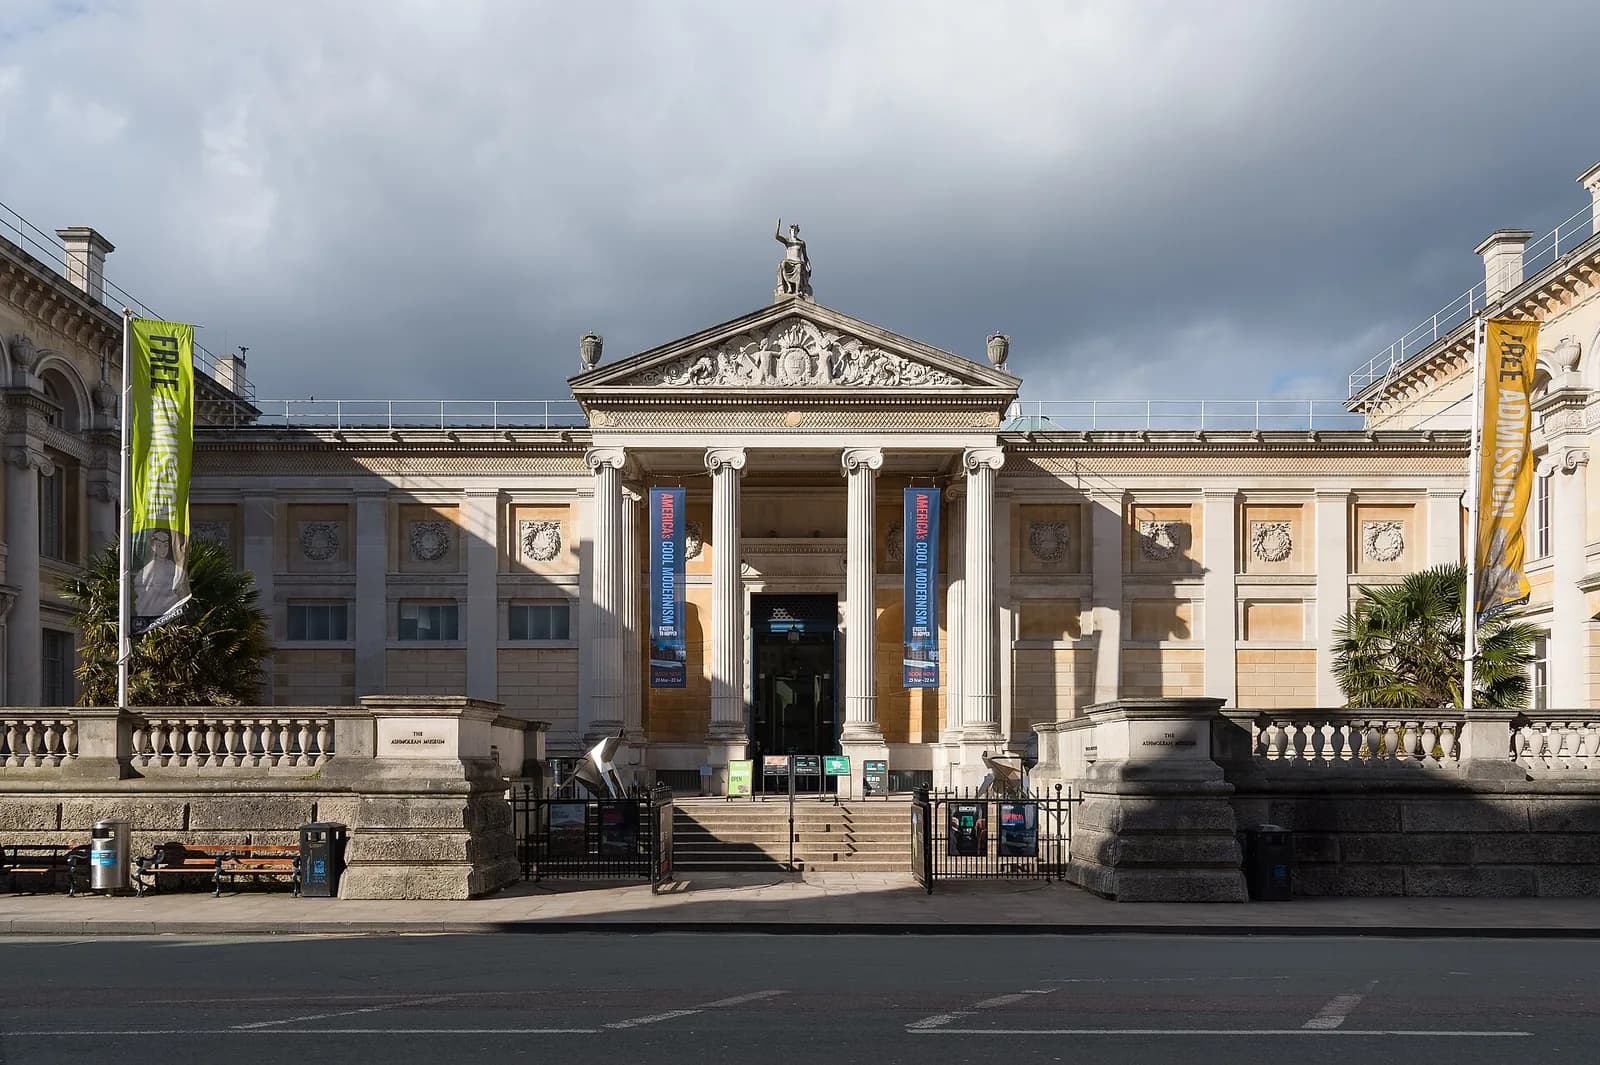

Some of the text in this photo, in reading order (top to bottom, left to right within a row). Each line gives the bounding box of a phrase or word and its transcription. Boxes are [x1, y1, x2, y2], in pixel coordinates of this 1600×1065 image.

[147, 335, 179, 520] FREE ADMISSION
[1491, 388, 1526, 517] ADMISSION
[661, 493, 674, 539] AMERICA'S
[916, 494, 929, 540] AMERICA'S
[662, 541, 674, 565] COOL
[916, 542, 928, 566] COOL
[662, 567, 674, 624] MODERNISM
[915, 568, 928, 625] MODERNISM
